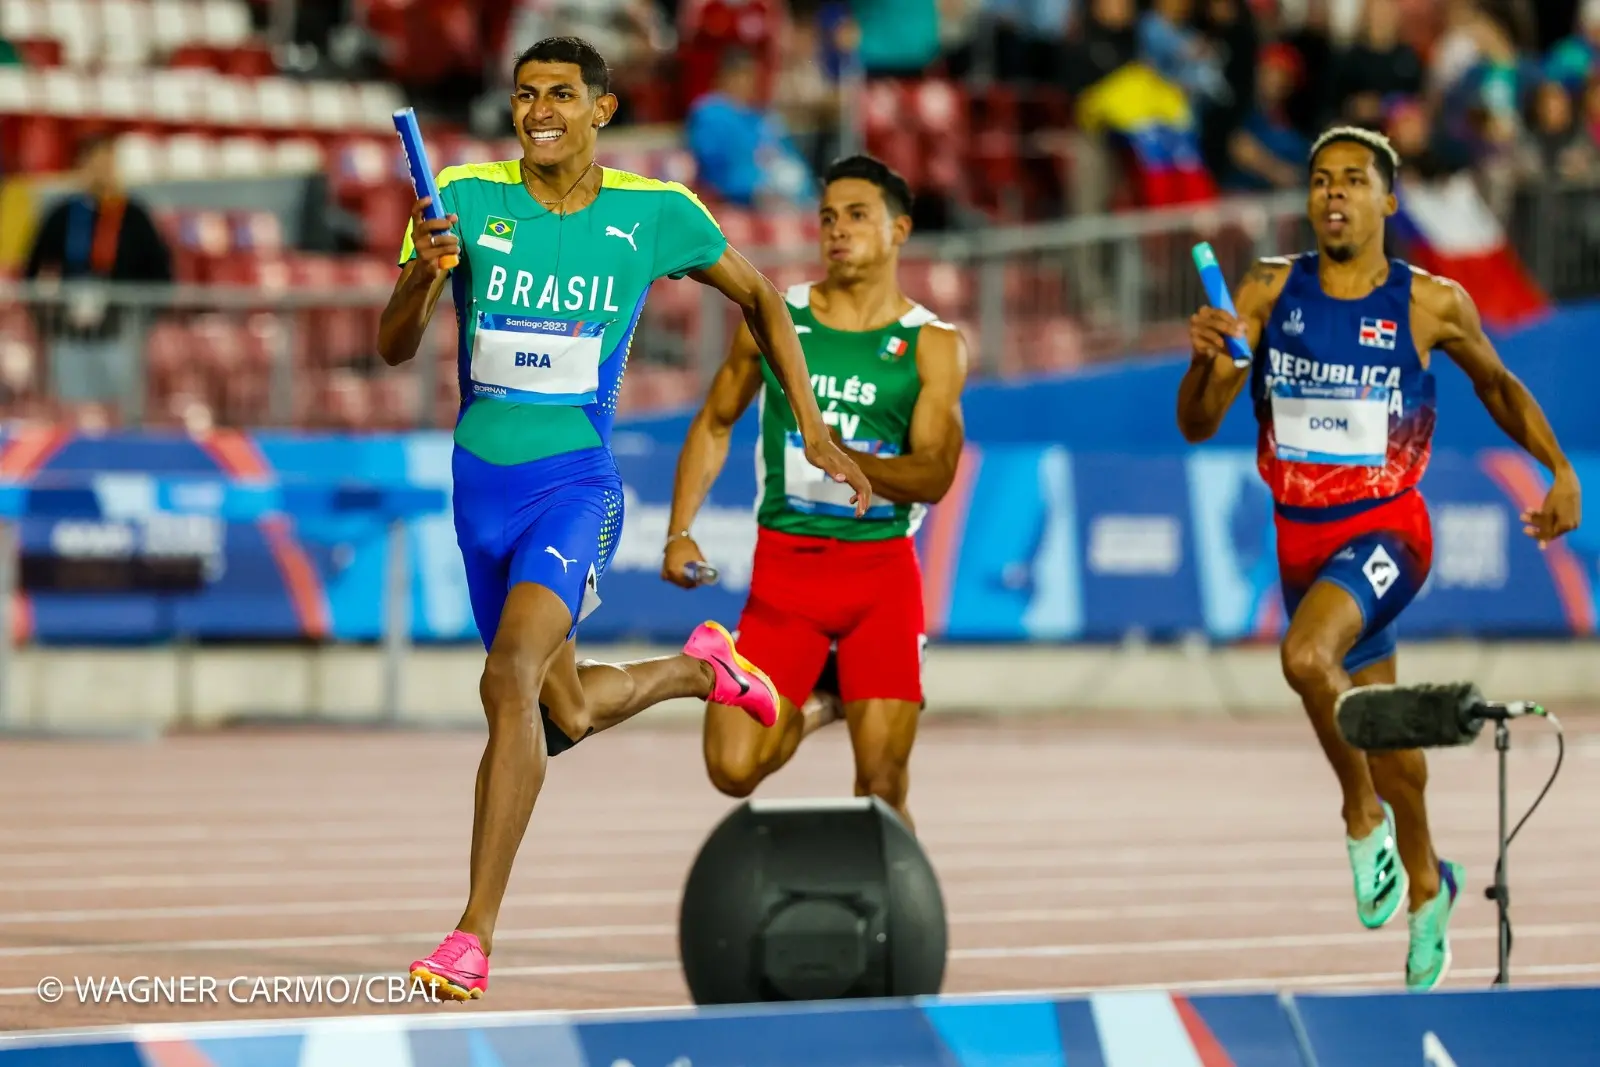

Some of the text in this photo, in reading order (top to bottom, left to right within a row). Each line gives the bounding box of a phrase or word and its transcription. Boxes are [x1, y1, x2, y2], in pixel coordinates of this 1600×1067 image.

[486, 264, 619, 312] BRASIL
[514, 351, 551, 368] BRA
[1309, 416, 1348, 431] DOM
